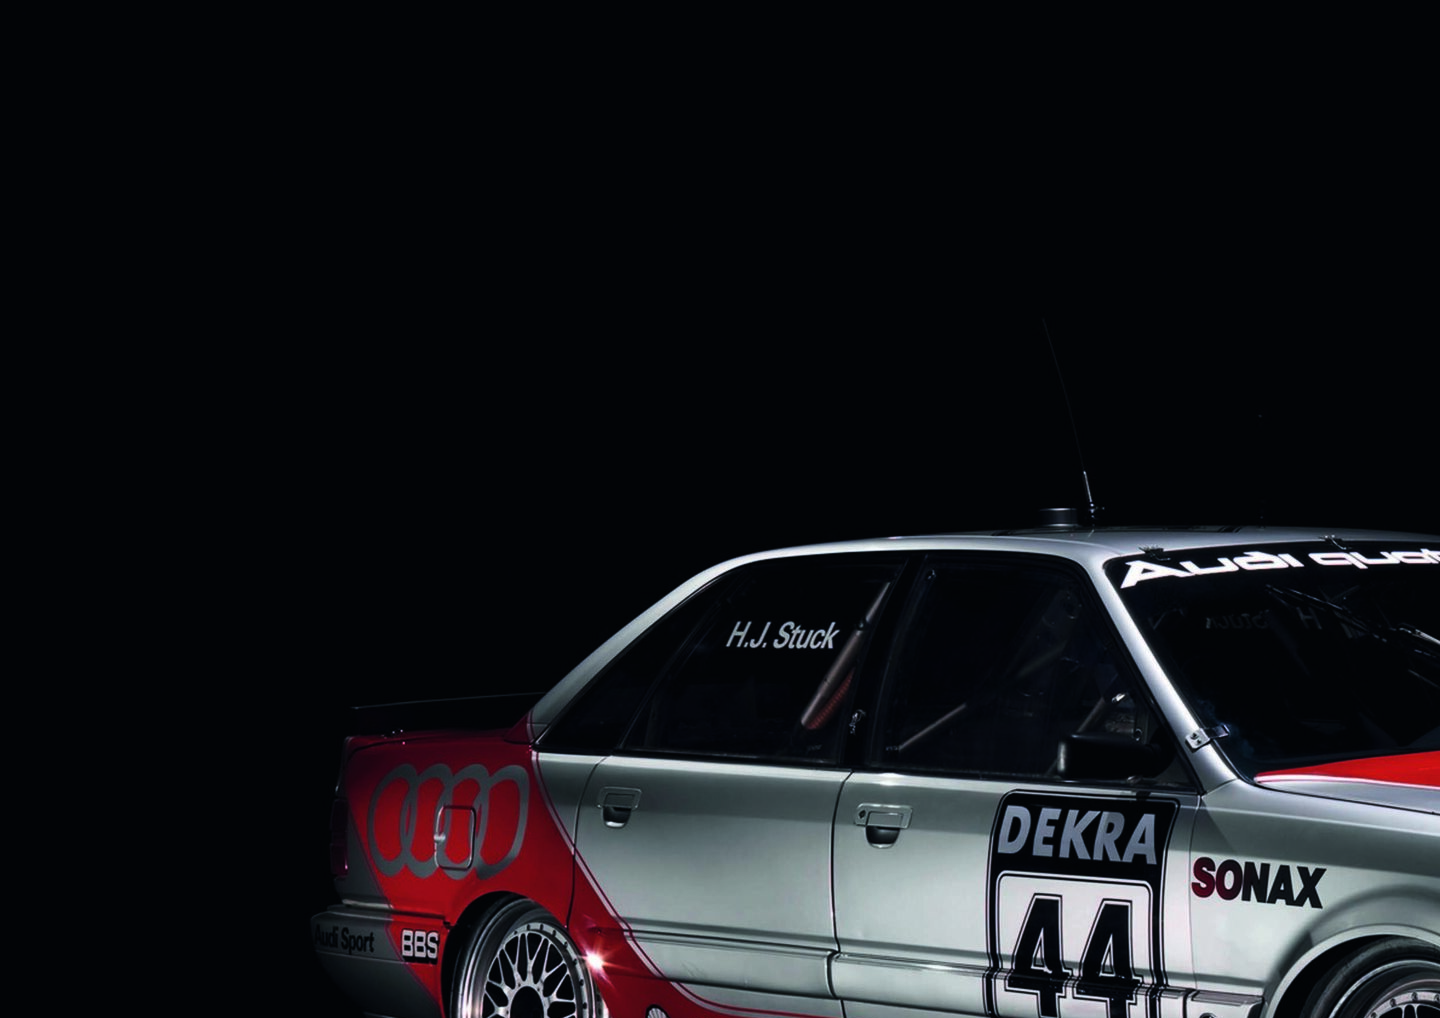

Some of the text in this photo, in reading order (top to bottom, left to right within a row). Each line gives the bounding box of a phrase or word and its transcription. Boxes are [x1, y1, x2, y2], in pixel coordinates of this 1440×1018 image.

[1120, 550, 1305, 590] Audi
[725, 620, 841, 649] H.J. Stuck
[997, 804, 1158, 865] DEKRA
[1191, 857, 1327, 909] SONAX
[313, 924, 375, 955] Audi Sport
[401, 928, 440, 961] BBS
